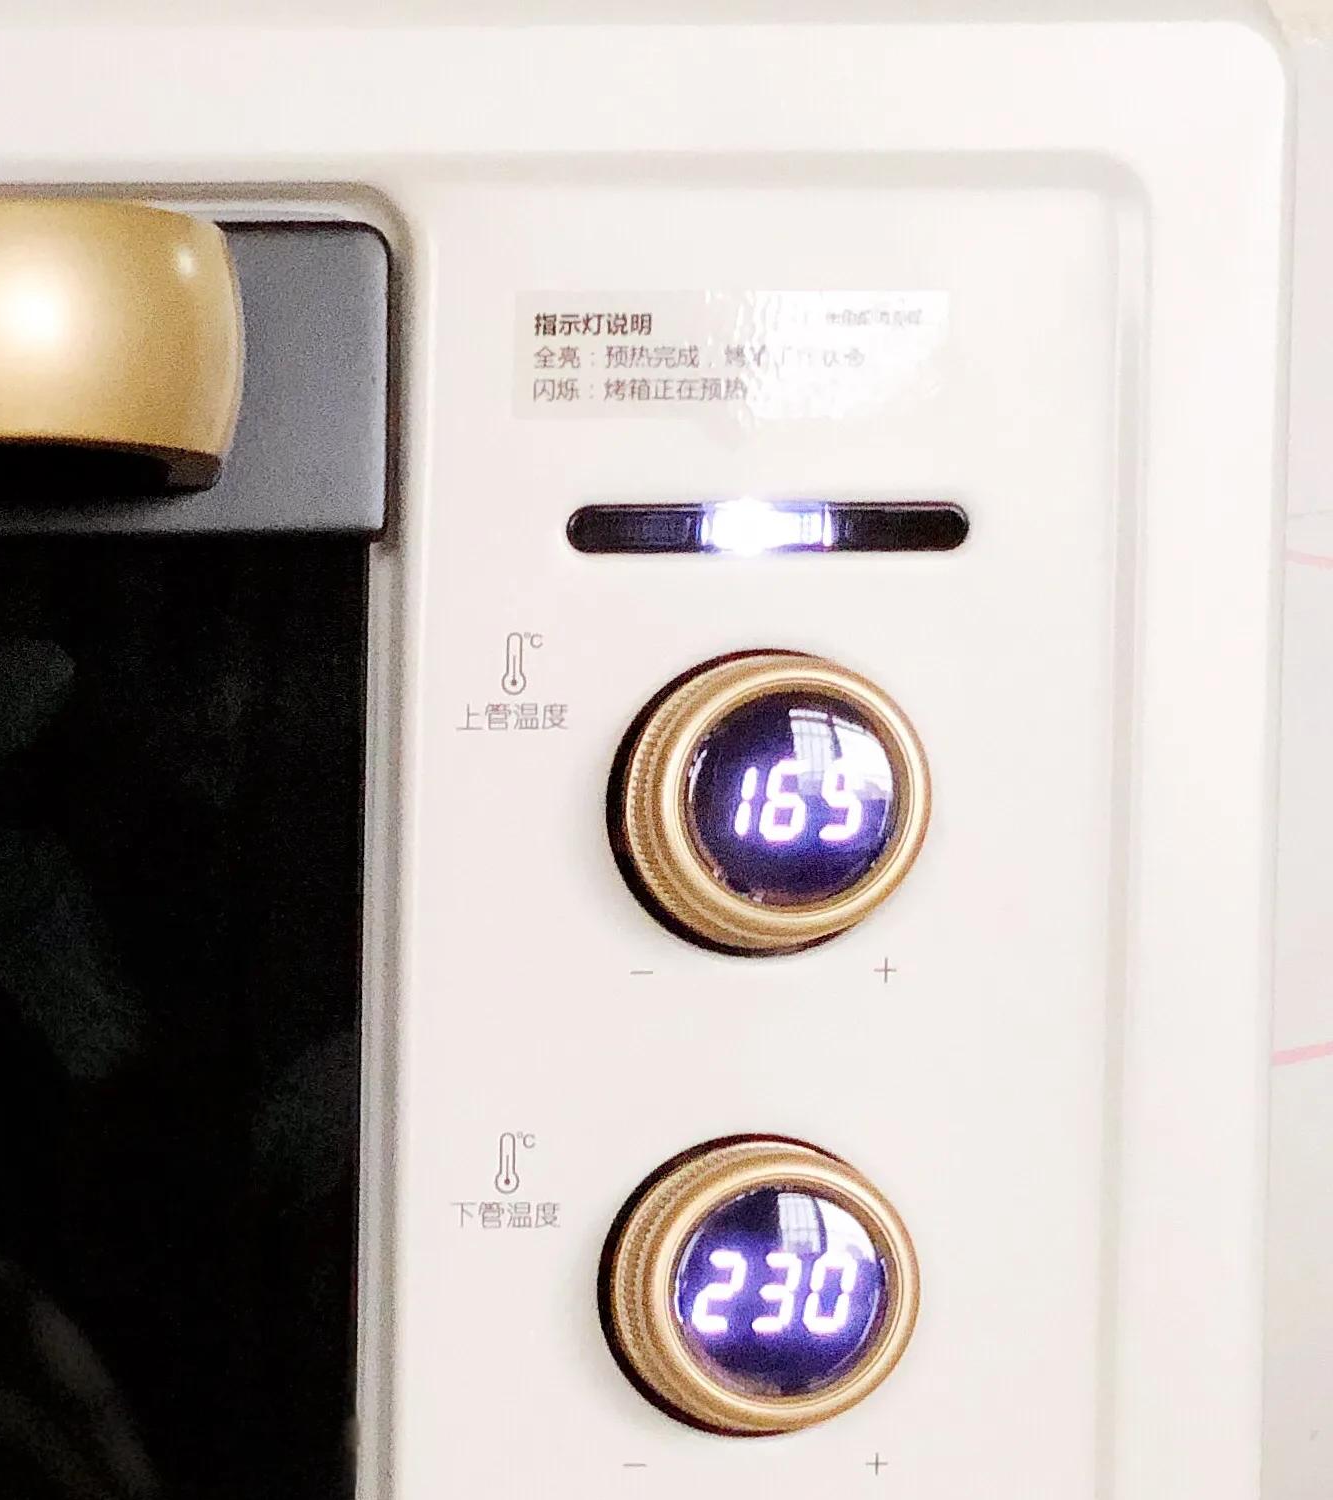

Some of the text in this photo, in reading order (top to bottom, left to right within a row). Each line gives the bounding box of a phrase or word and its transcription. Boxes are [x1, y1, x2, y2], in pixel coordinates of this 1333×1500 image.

[534, 312, 653, 336] 指示灯说明
[455, 702, 569, 731] 上管温度
[734, 758, 863, 843] 165
[450, 1201, 561, 1229] 下管温度
[690, 1248, 858, 1334] 230
